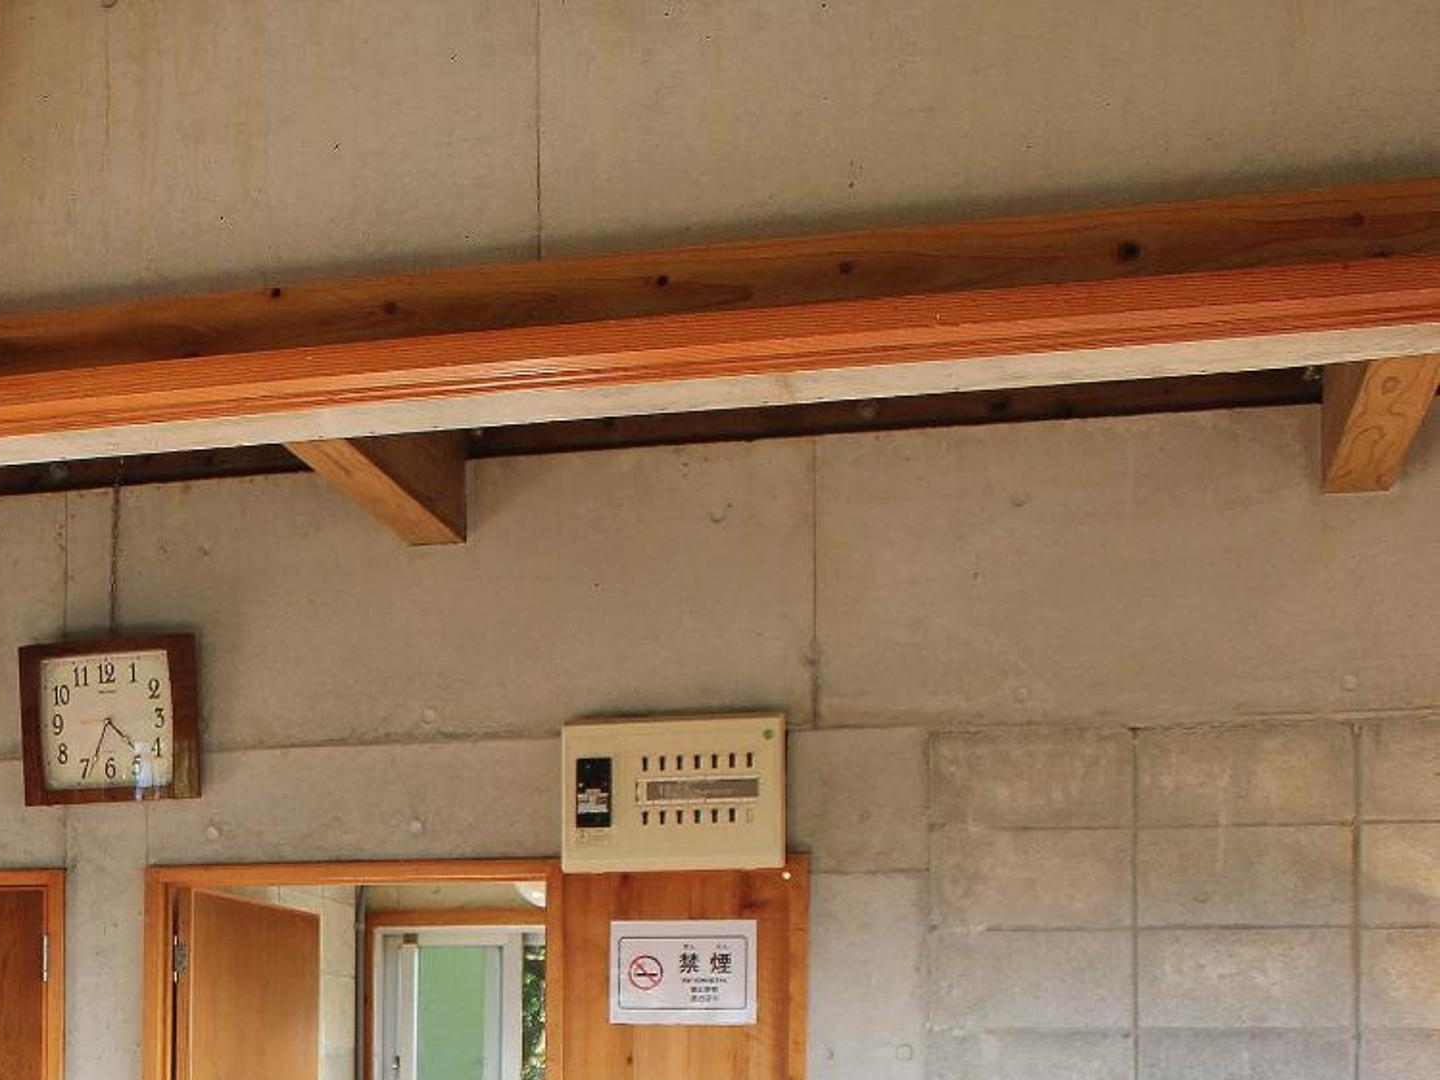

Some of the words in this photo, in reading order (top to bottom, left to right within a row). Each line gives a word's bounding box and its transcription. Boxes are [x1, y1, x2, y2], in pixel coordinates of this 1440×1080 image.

[73, 665, 89, 687] 11
[97, 662, 116, 684] 12
[129, 662, 137, 683] 1
[52, 684, 70, 707] 10
[147, 678, 161, 700] 2
[52, 714, 64, 736] 9
[155, 707, 165, 728] 3
[58, 743, 68, 765] 8
[151, 736, 161, 758] 4
[80, 758, 91, 780] 7
[105, 758, 116, 779] 6
[679, 952, 732, 974] 禁煙
